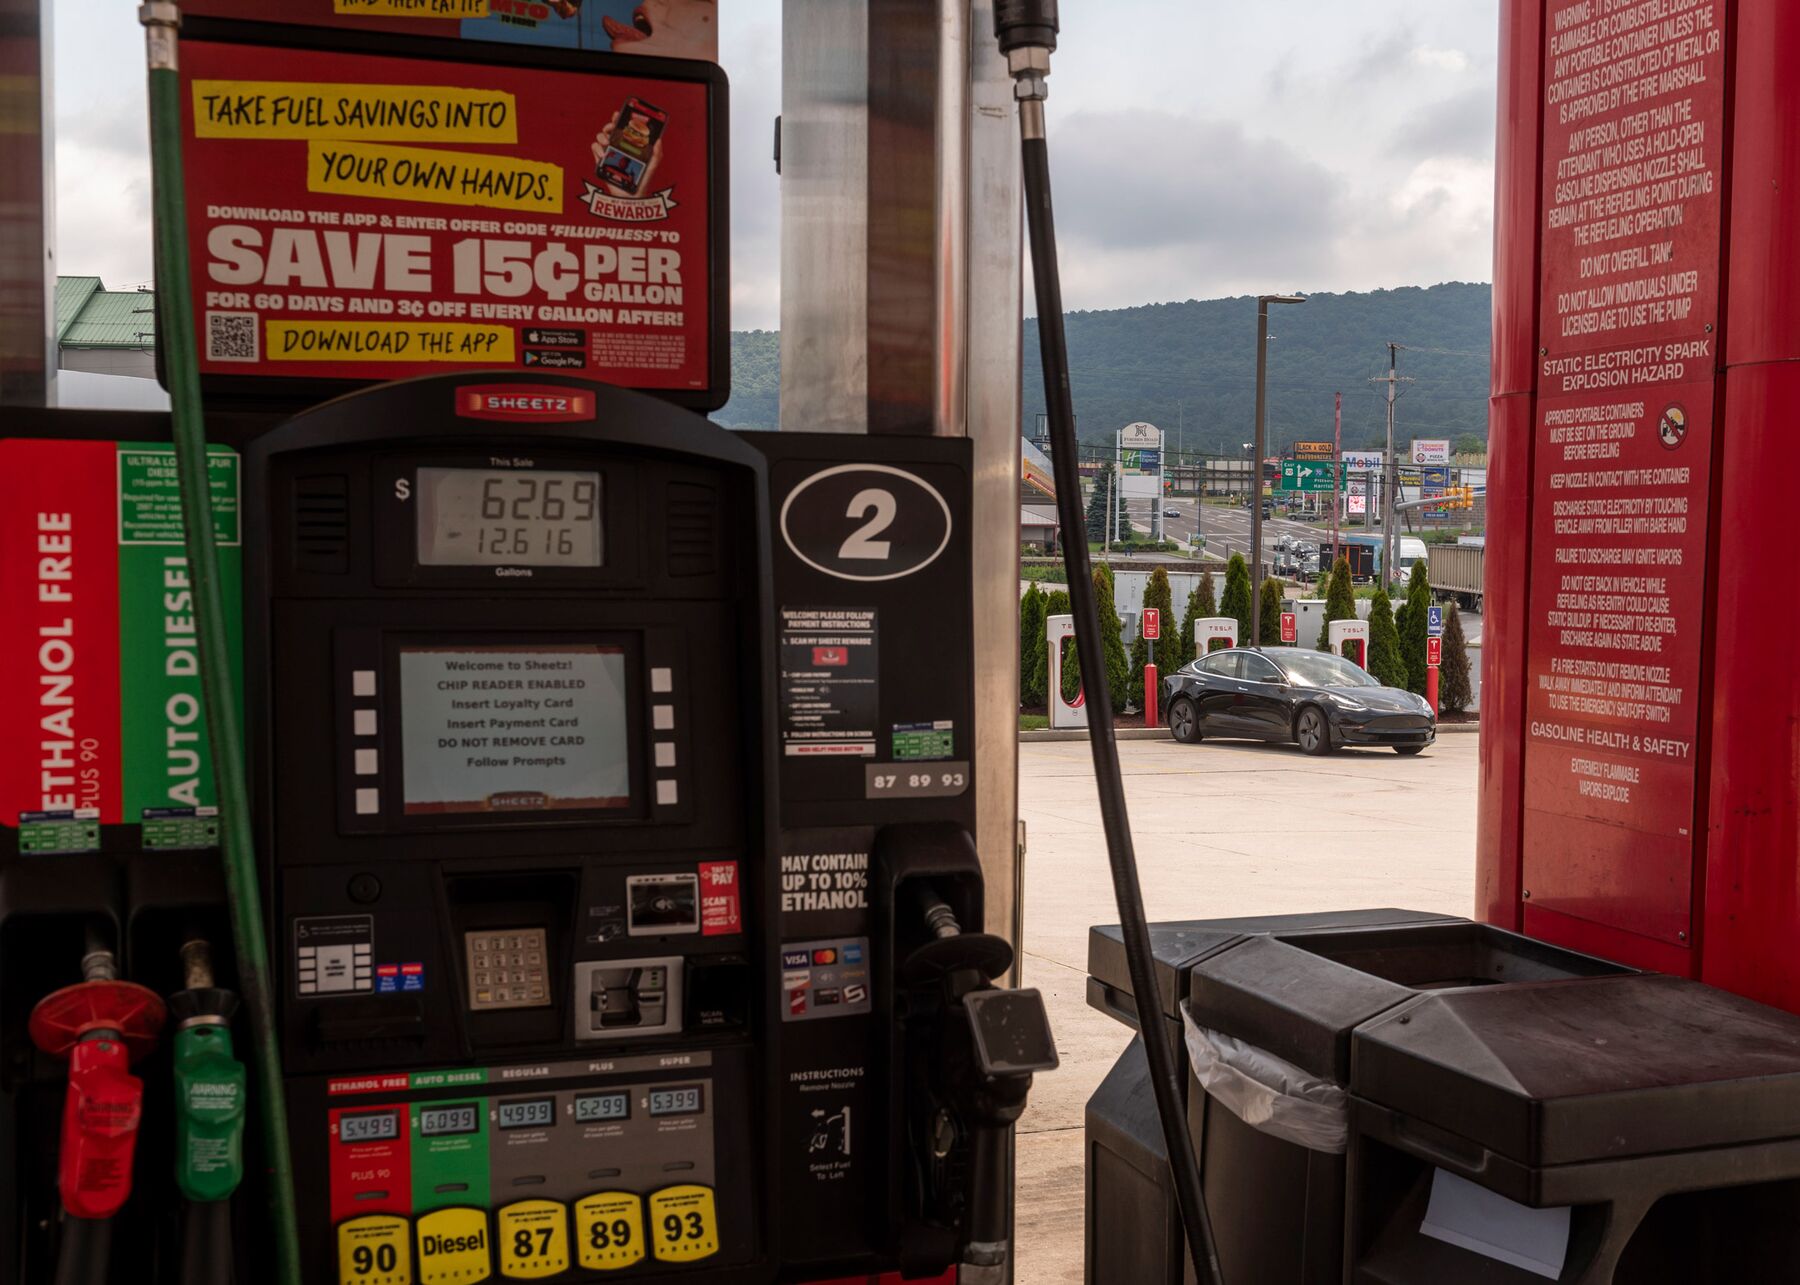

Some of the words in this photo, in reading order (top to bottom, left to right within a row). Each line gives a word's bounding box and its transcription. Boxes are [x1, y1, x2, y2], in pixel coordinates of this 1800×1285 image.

[1554, 55, 1570, 79] ANY
[1571, 41, 1611, 73] PORTABLE
[1612, 27, 1659, 59] CONTAINER
[1660, 12, 1694, 43] UNLESS
[1695, 5, 1713, 31] THE
[1560, 103, 1567, 125] IS
[1568, 89, 1609, 121] APPROVED
[1610, 85, 1622, 110] BY
[1623, 81, 1638, 106] THE
[1640, 74, 1659, 101] FIRE
[1660, 60, 1706, 96] MARSHALL
[203, 95, 266, 126] TAKE
[272, 96, 329, 127] FUEL
[333, 98, 440, 129] SAVINGS
[446, 99, 506, 128] INTO
[323, 151, 385, 184] YOUR
[392, 161, 457, 191] OWN
[462, 166, 553, 203] HANDS.
[595, 201, 663, 219] REWARDZ
[207, 206, 304, 223] DOWNLOAD
[307, 211, 339, 225] THE
[343, 213, 376, 227] APP
[380, 214, 393, 228] &
[396, 216, 445, 231] ENTER
[450, 219, 501, 233] OFFER
[504, 221, 546, 235] CODE
[660, 229, 681, 243] TO
[207, 224, 431, 294] SAVE
[452, 238, 580, 301] 15¢
[584, 244, 682, 284] PER
[584, 283, 684, 306] GALLON
[207, 291, 250, 308] FOR
[254, 293, 283, 310] 60
[288, 295, 344, 313] DAYS
[348, 298, 391, 315] AND
[397, 300, 424, 319] 3¢
[428, 301, 466, 319] OFF
[470, 303, 535, 321] EVERY
[539, 305, 612, 323] GALLON
[615, 308, 684, 327] AFTER!
[282, 329, 409, 355] DOWNLOAD
[417, 332, 454, 353] THE
[461, 332, 498, 354] APP
[541, 336, 558, 345] App
[559, 336, 578, 345] Store
[541, 357, 566, 366] Google
[568, 358, 582, 366] Play
[1543, 357, 1581, 377] STATIC
[1584, 346, 1661, 370] ELECTRICITY
[1664, 340, 1709, 361] SPARK
[1563, 369, 1628, 391] EXPLOSION
[1631, 363, 1684, 384] HAZARD
[488, 397, 568, 410] SHEETZ
[127, 456, 162, 466] ULTRA
[163, 457, 178, 466] LO
[490, 457, 511, 467] This
[513, 458, 534, 467] Sale
[1346, 457, 1379, 468] Mobil
[147, 467, 178, 477] DIESE
[395, 478, 410, 501] $
[482, 479, 597, 521] 62.69
[838, 488, 898, 559] 2
[478, 528, 573, 555] 12.616
[38, 512, 73, 603] FREE
[496, 567, 533, 578] Gallons
[783, 611, 819, 620] WELCOME!
[820, 611, 845, 620] PLEASE
[847, 611, 875, 620] FOLLOW
[788, 620, 820, 628] PAYMENT
[821, 620, 871, 628] INSTRUCTIONS
[445, 660, 503, 671] Welcome
[508, 661, 520, 671] to
[525, 660, 572, 671] Sheetz!
[437, 680, 468, 691] CHIP
[473, 680, 523, 690] READER
[528, 679, 585, 689] ENABLED
[451, 699, 489, 709] Insert
[494, 698, 540, 712] Loyalty
[544, 697, 573, 708] Card
[39, 618, 76, 812] ETHANOL
[447, 718, 485, 729] Insert
[490, 717, 545, 731] Payment
[549, 716, 579, 728] Card
[81, 737, 99, 760] 90
[438, 738, 456, 748] DO
[462, 738, 488, 748] NOT
[493, 737, 546, 747] REMOVE
[551, 736, 584, 746] CARD
[1531, 721, 1584, 743] GASOLINE
[1587, 728, 1630, 750] HEALTH
[1632, 736, 1640, 752] &
[1644, 737, 1689, 758] SAFETY
[166, 692, 200, 806] AUTO
[467, 756, 508, 767] Follow
[513, 756, 566, 769] Prompts
[81, 764, 100, 810] PLUS
[875, 775, 897, 788] 87
[909, 775, 931, 787] 89
[941, 774, 963, 786] 93
[491, 797, 544, 806] SHEETZ
[782, 855, 809, 872] MAY
[812, 853, 868, 871] CONTAIN
[712, 873, 734, 885] PAY
[782, 874, 805, 890] UP
[809, 873, 831, 889] TO
[834, 871, 868, 889] 10%
[703, 897, 727, 906] SCAN
[782, 890, 869, 912] ETHANOL
[785, 953, 808, 966] VISA
[589, 1062, 614, 1071] PLUS
[660, 1056, 691, 1066] SUPER
[416, 1074, 443, 1085] AUTO
[447, 1072, 481, 1083] DIESEL
[502, 1067, 549, 1079] REGULAR
[790, 1067, 864, 1082] INSTRUCTIONS
[190, 1082, 237, 1096] WARNING
[330, 1078, 379, 1092] ETHANOL
[382, 1077, 408, 1088] FREE
[580, 1098, 623, 1116] 5.299
[653, 1090, 695, 1109] 5.399
[425, 1111, 471, 1130] 6.099
[503, 1104, 548, 1122] 4.999
[346, 1118, 393, 1137] 5.499
[352, 1169, 375, 1182] PLUS
[377, 1168, 391, 1179] 90
[817, 1172, 826, 1180] To
[589, 1219, 631, 1251] 89
[663, 1211, 704, 1243] 93
[423, 1230, 485, 1257] Diesel
[513, 1228, 555, 1258] 87
[352, 1242, 397, 1275] 90
